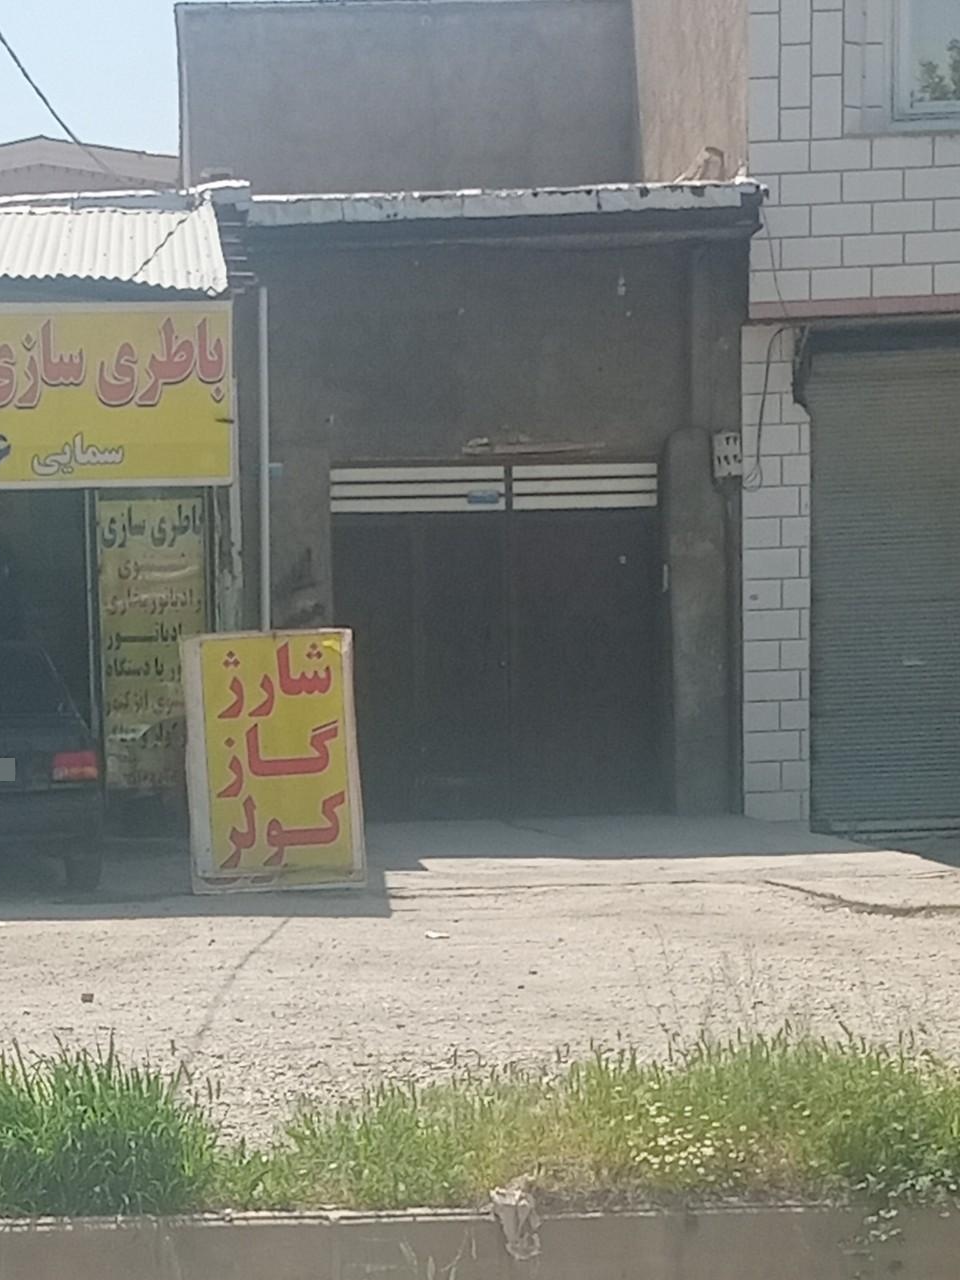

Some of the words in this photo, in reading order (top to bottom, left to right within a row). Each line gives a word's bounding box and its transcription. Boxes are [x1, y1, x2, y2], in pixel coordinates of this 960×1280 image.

[98, 317, 226, 406] باطری
[32, 432, 124, 475] سمایی
[101, 504, 146, 548] سازی
[217, 642, 333, 719] شارژ
[217, 719, 339, 799] گاز
[220, 790, 346, 869] کولر
